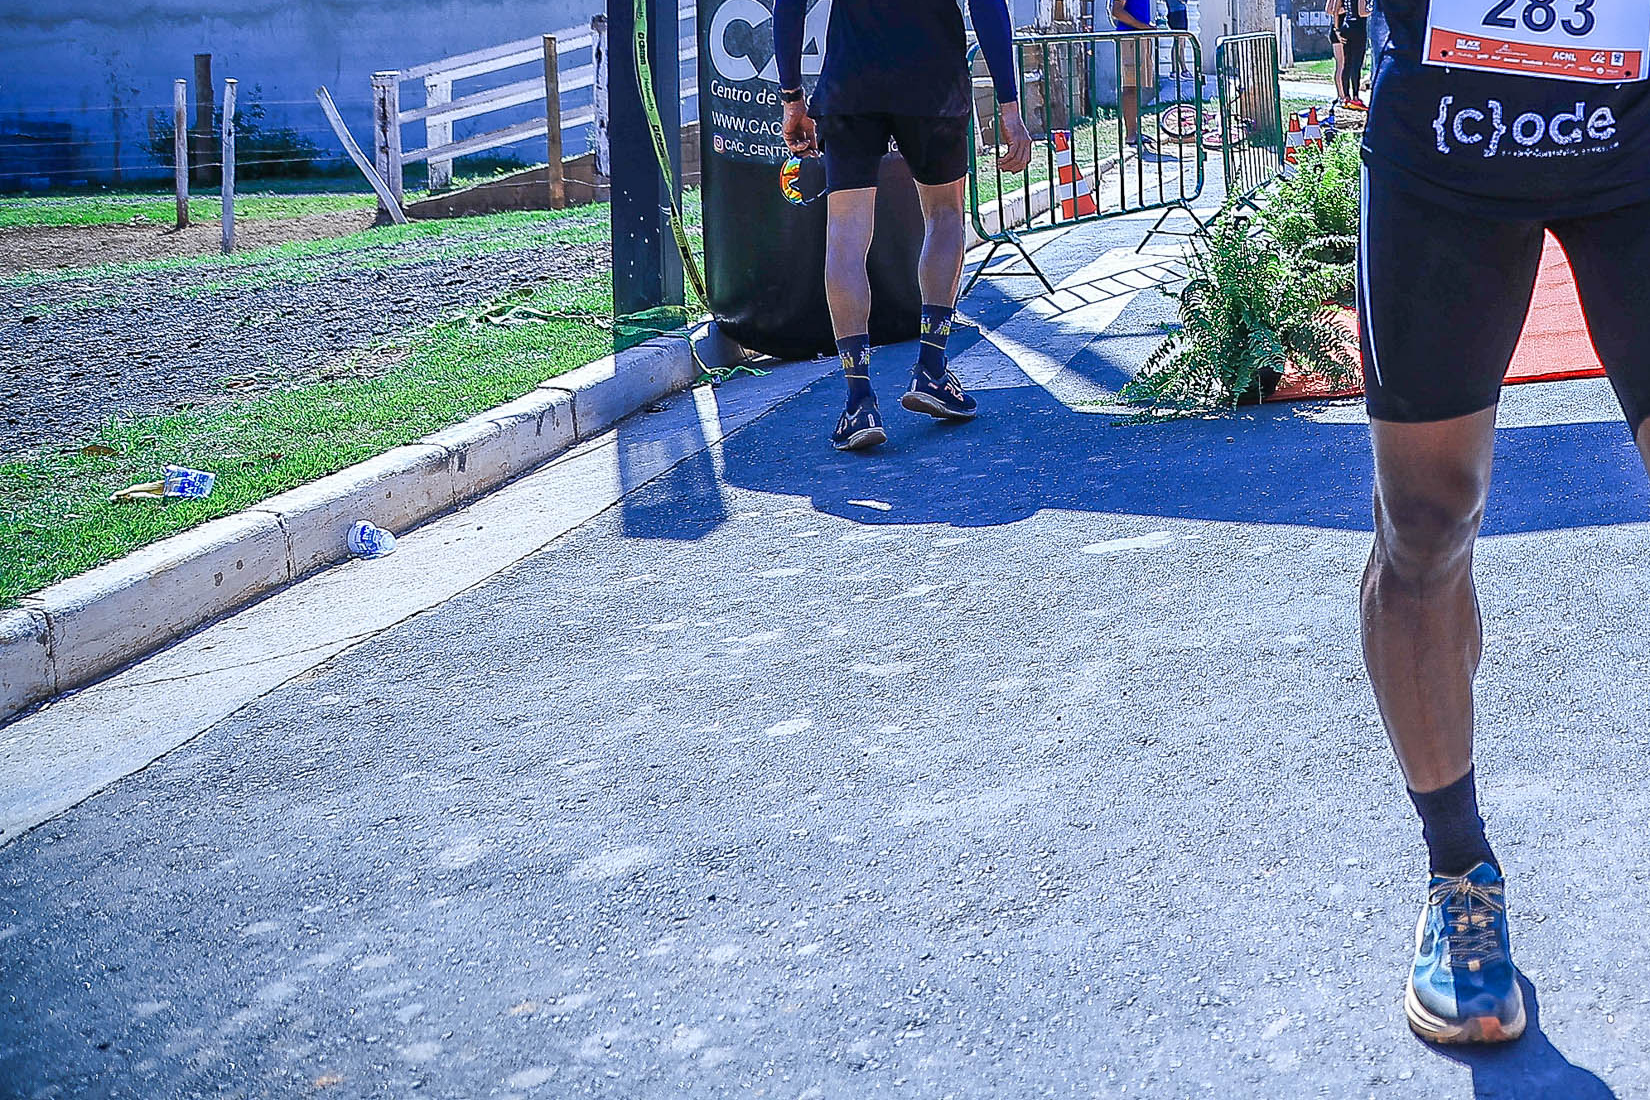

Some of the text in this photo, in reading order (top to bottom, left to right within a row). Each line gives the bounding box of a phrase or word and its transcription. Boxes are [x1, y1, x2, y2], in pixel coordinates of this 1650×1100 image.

[711, 80, 752, 102] Centro
[756, 87, 777, 106] de
[1432, 95, 1617, 159] {c}ode
